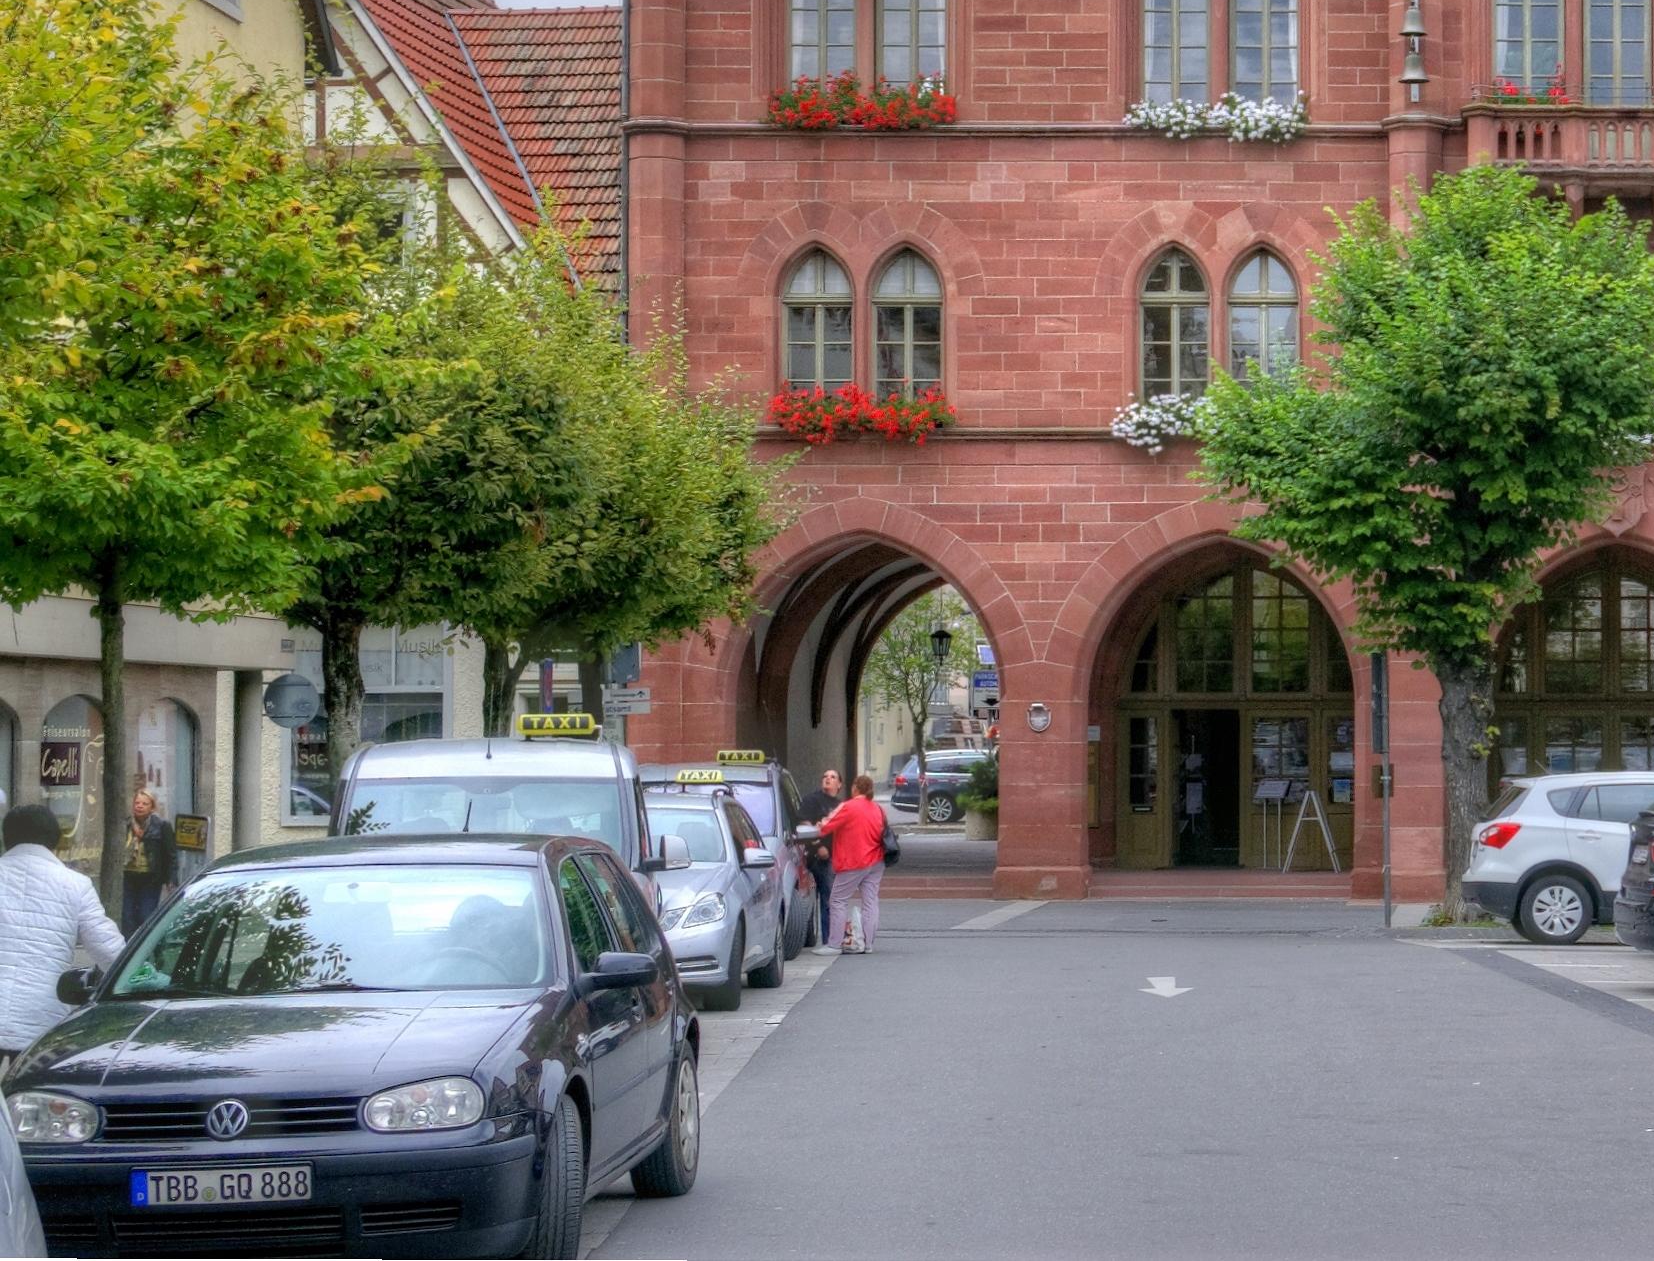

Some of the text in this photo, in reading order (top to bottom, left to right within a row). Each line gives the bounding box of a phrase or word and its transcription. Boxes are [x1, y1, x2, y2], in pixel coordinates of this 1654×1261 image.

[531, 716, 582, 730] TAXI
[43, 725, 91, 737] Friseursalon
[723, 752, 756, 761] TAXI
[41, 746, 78, 783] Capelli
[683, 770, 719, 781] TAXI
[150, 1170, 309, 1203] TBB GQ 888
